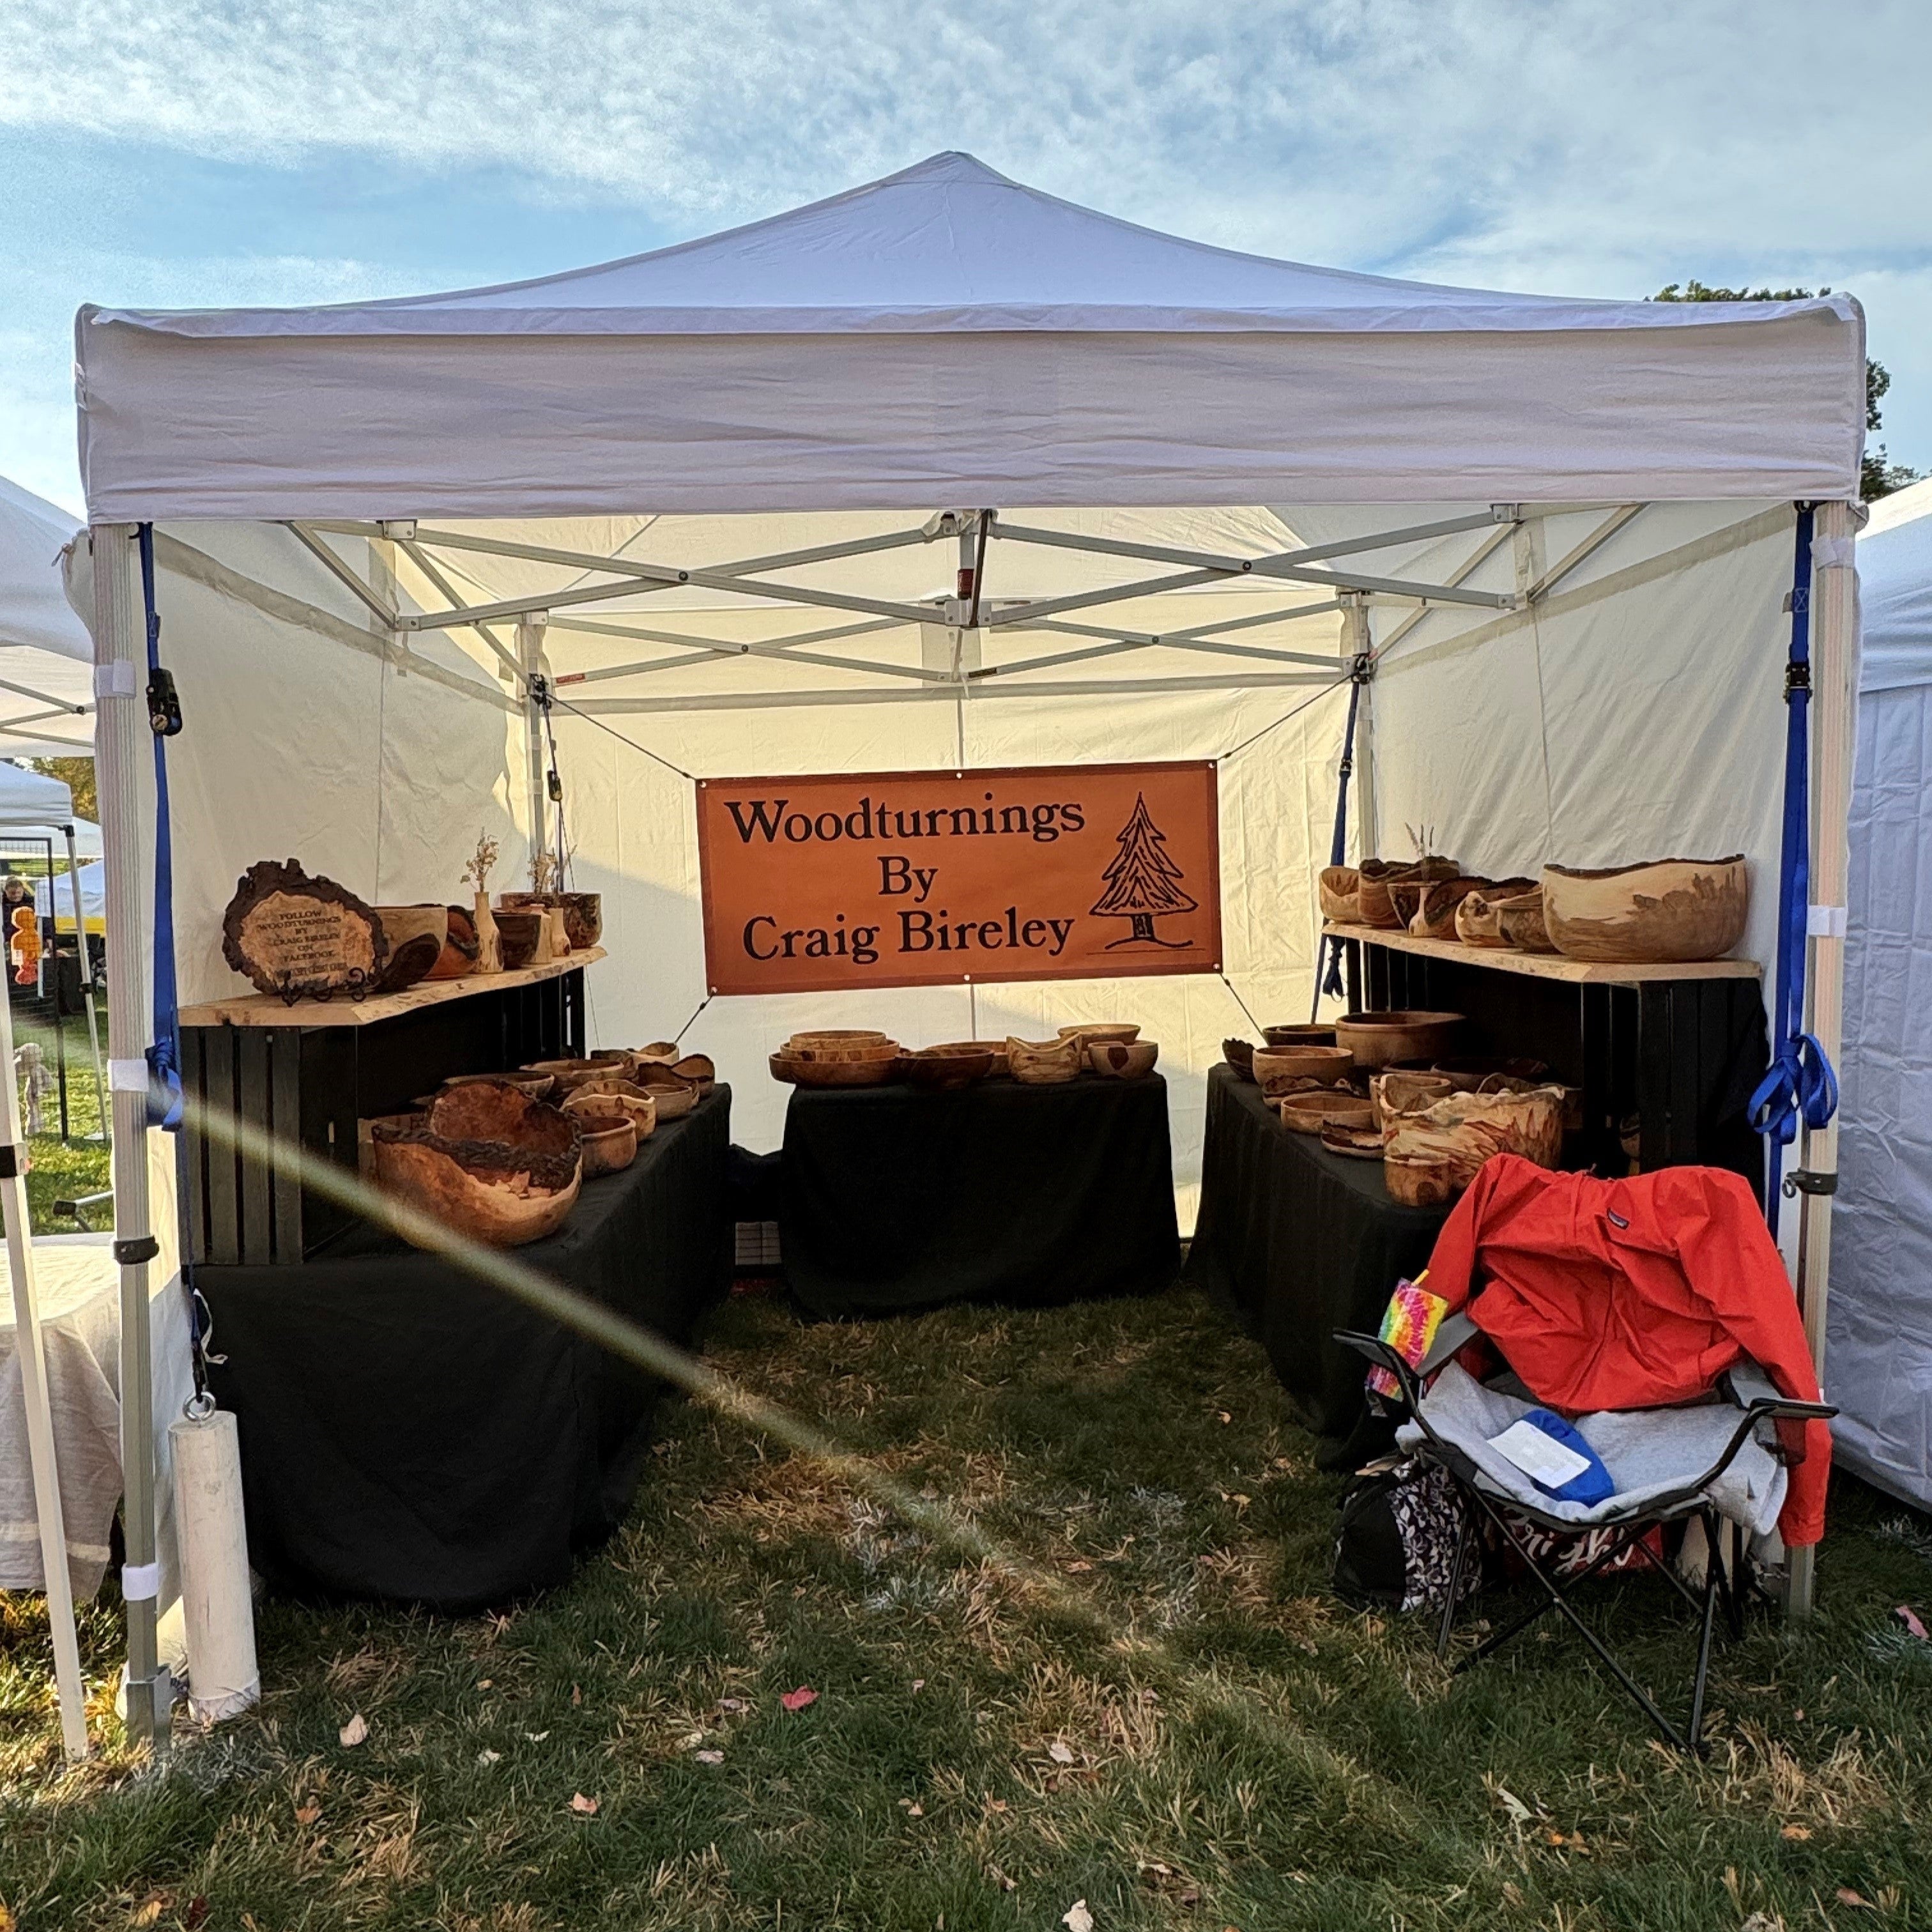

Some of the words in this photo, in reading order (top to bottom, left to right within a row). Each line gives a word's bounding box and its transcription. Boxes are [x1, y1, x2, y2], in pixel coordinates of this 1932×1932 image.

[723, 792, 1085, 843] Woodturnings
[877, 856, 939, 903] By
[279, 910, 321, 920] FOLLOW
[743, 914, 880, 965] Craig
[897, 906, 1075, 956] Bireley
